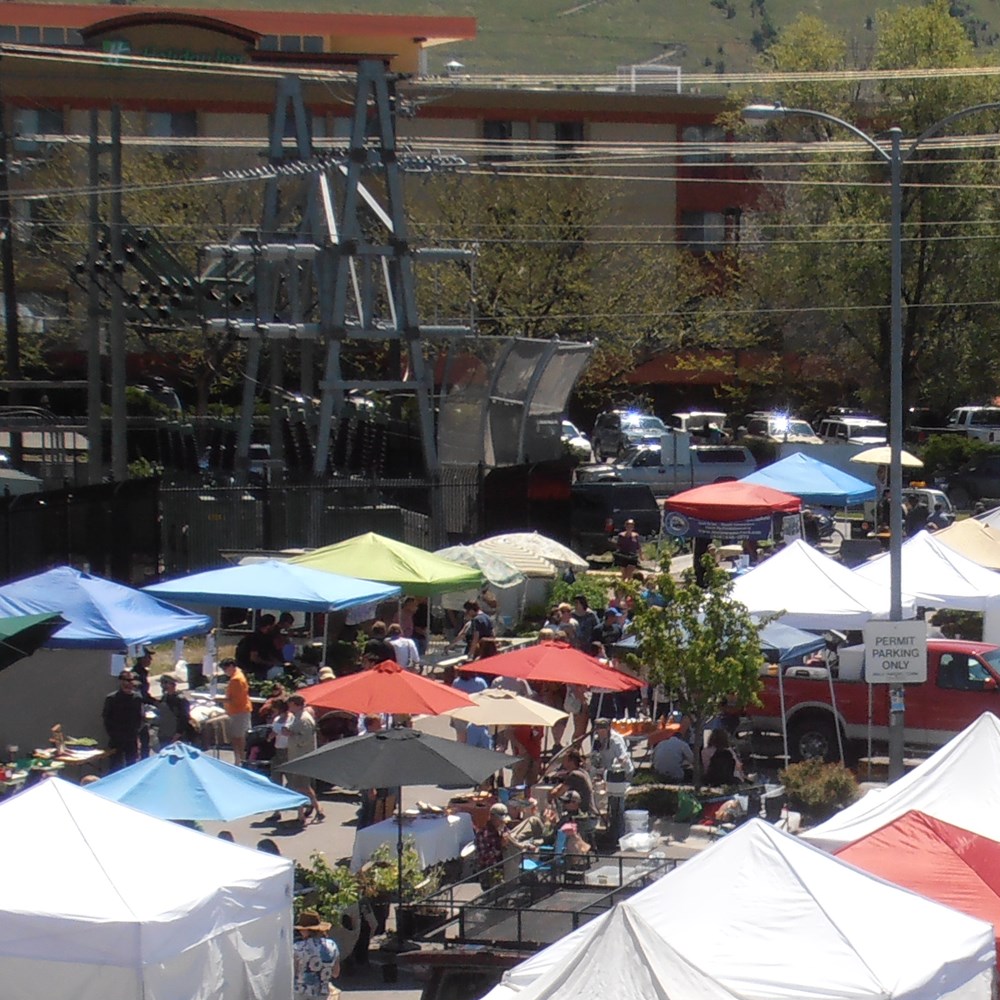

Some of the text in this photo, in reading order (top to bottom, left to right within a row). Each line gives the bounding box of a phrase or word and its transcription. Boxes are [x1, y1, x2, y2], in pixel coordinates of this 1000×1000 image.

[875, 636, 915, 646] PERMIT
[872, 648, 920, 658] PARKING
[882, 660, 910, 670] ONLY
